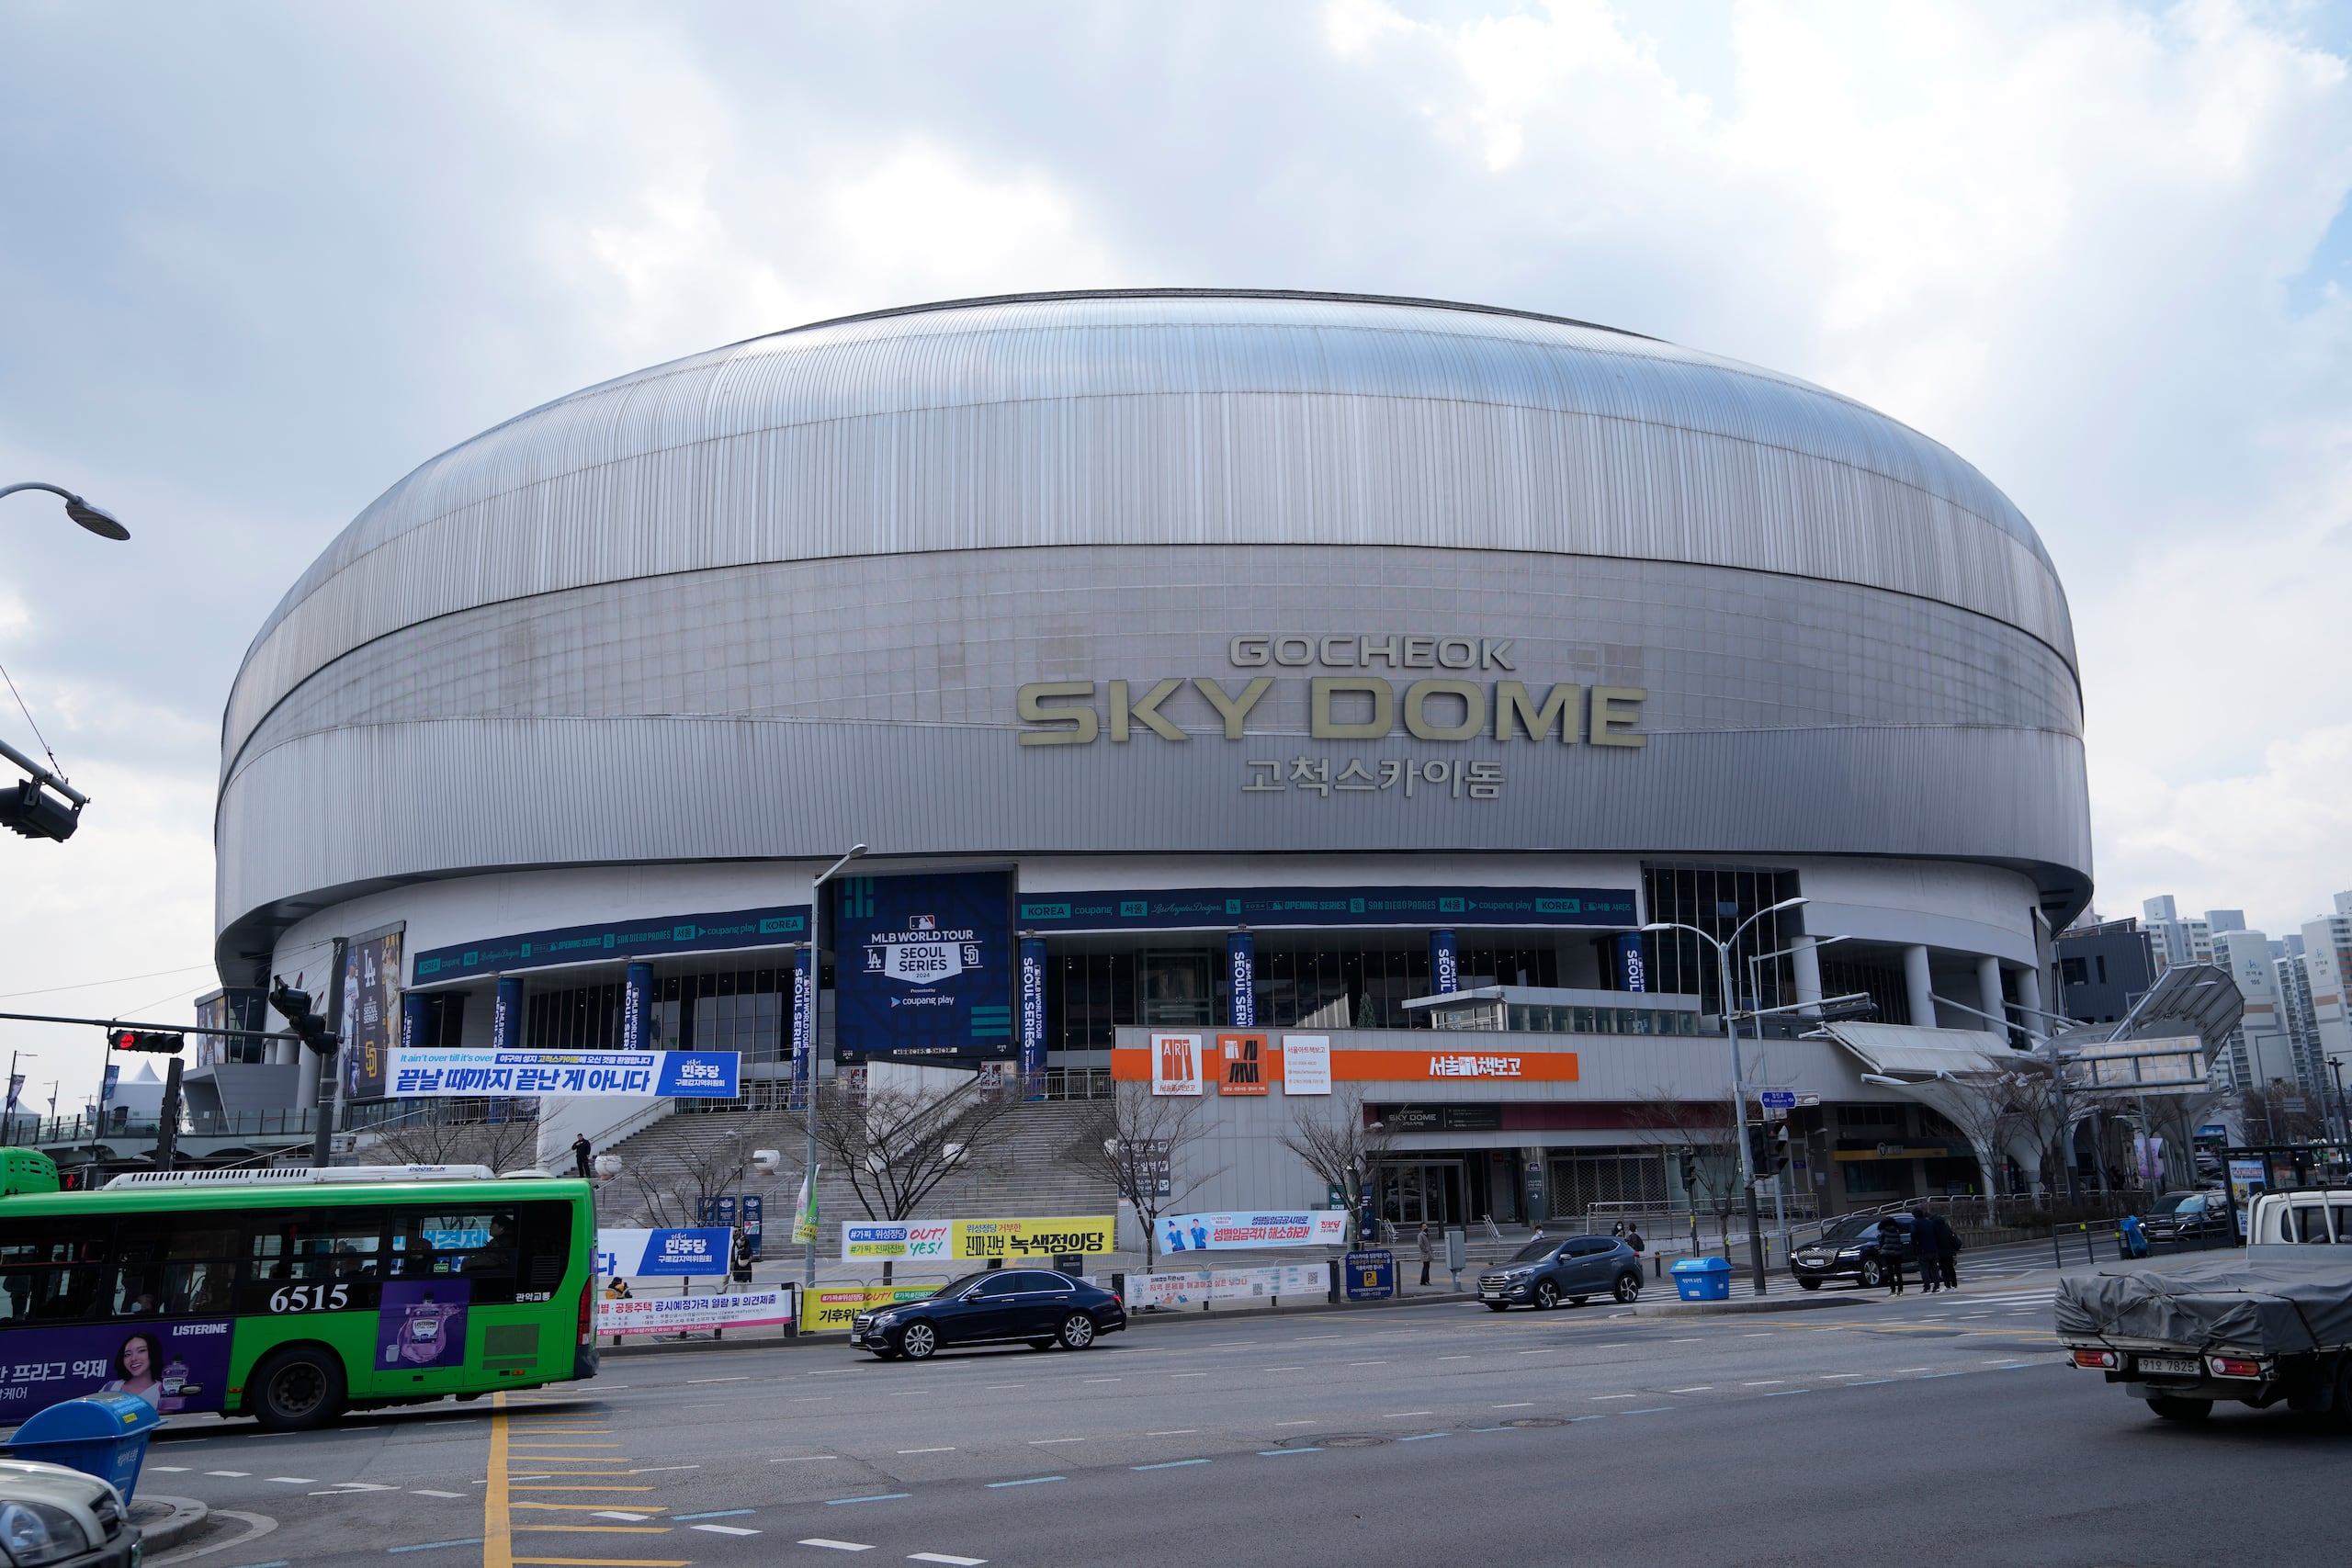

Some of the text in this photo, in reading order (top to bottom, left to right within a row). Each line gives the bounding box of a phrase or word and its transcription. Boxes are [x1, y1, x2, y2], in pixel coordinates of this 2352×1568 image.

[1229, 635, 1517, 670] GOCHEOK
[1017, 676, 1648, 749] SKY DOME
[1241, 756, 1506, 798] 고척스카이돔
[1074, 905, 1113, 916] coupang
[1193, 902, 1222, 914] Dodgers
[1284, 901, 1346, 910] OPENING SERIES
[1368, 900, 1436, 910] SAN DIEGO PADRES
[1443, 899, 1461, 910] 서울
[1479, 900, 1532, 912] coupang play
[1542, 901, 1575, 911] KOREA
[1028, 907, 1065, 916] KOREA
[707, 923, 756, 937] coupang play
[765, 919, 798, 931] KOREA
[616, 935, 628, 944] SAN
[629, 932, 647, 943] DIEGO
[677, 927, 692, 938] 서울
[872, 930, 974, 944] MLB WORLD TOUR
[559, 940, 581, 950] OPENING
[582, 937, 601, 947] SERIES
[867, 949, 882, 969] LA
[899, 946, 946, 959] SEOUL
[899, 959, 947, 972] SERIES
[1439, 949, 1452, 991] SEOUL
[1627, 950, 1639, 992] SEOUL
[1235, 952, 1247, 1027] SEOUL SERI
[902, 995, 955, 1006] coupang play
[1023, 957, 1035, 1048] SEOUL SERIES
[794, 968, 803, 1057] SEOUL SERIES
[1163, 1043, 1190, 1055] ART
[401, 1055, 406, 1063] It
[408, 1054, 427, 1063] ain't
[449, 1054, 460, 1063] till
[460, 1055, 473, 1063] it's
[500, 1055, 522, 1063] 야구의
[538, 1055, 587, 1064] 고척스카이돔에
[587, 1055, 601, 1064] 오신
[602, 1055, 616, 1064] 것을
[617, 1056, 650, 1065] 환영합니다
[681, 1065, 720, 1078] 민주당
[396, 1068, 650, 1092] 끝날 때까지 끝난 게 아니다
[675, 1078, 725, 1087] 구로갑지역위원회
[967, 1224, 1022, 1233] 위성정당 거부한
[1320, 1220, 1341, 1229] 진보당
[910, 1227, 947, 1240] OUT!
[1214, 1225, 1310, 1242] 성별임금격차 해소하라!
[665, 1239, 707, 1254] 민주당
[910, 1242, 942, 1256] YES!
[987, 1235, 1003, 1256] 진보
[1010, 1232, 1105, 1255] 녹색정의당
[658, 1255, 712, 1263] 구로갑지역위원회
[269, 1283, 349, 1313] 6515
[515, 1292, 550, 1303] 관악교통
[865, 1292, 891, 1302] OUT!
[616, 1294, 776, 1314] 공동주택 공시예정가격 열람 및 의견제출
[172, 1323, 229, 1336] LISTERINE
[11, 1359, 107, 1382] 프라그 억제
[2166, 1360, 2195, 1372] 7825
